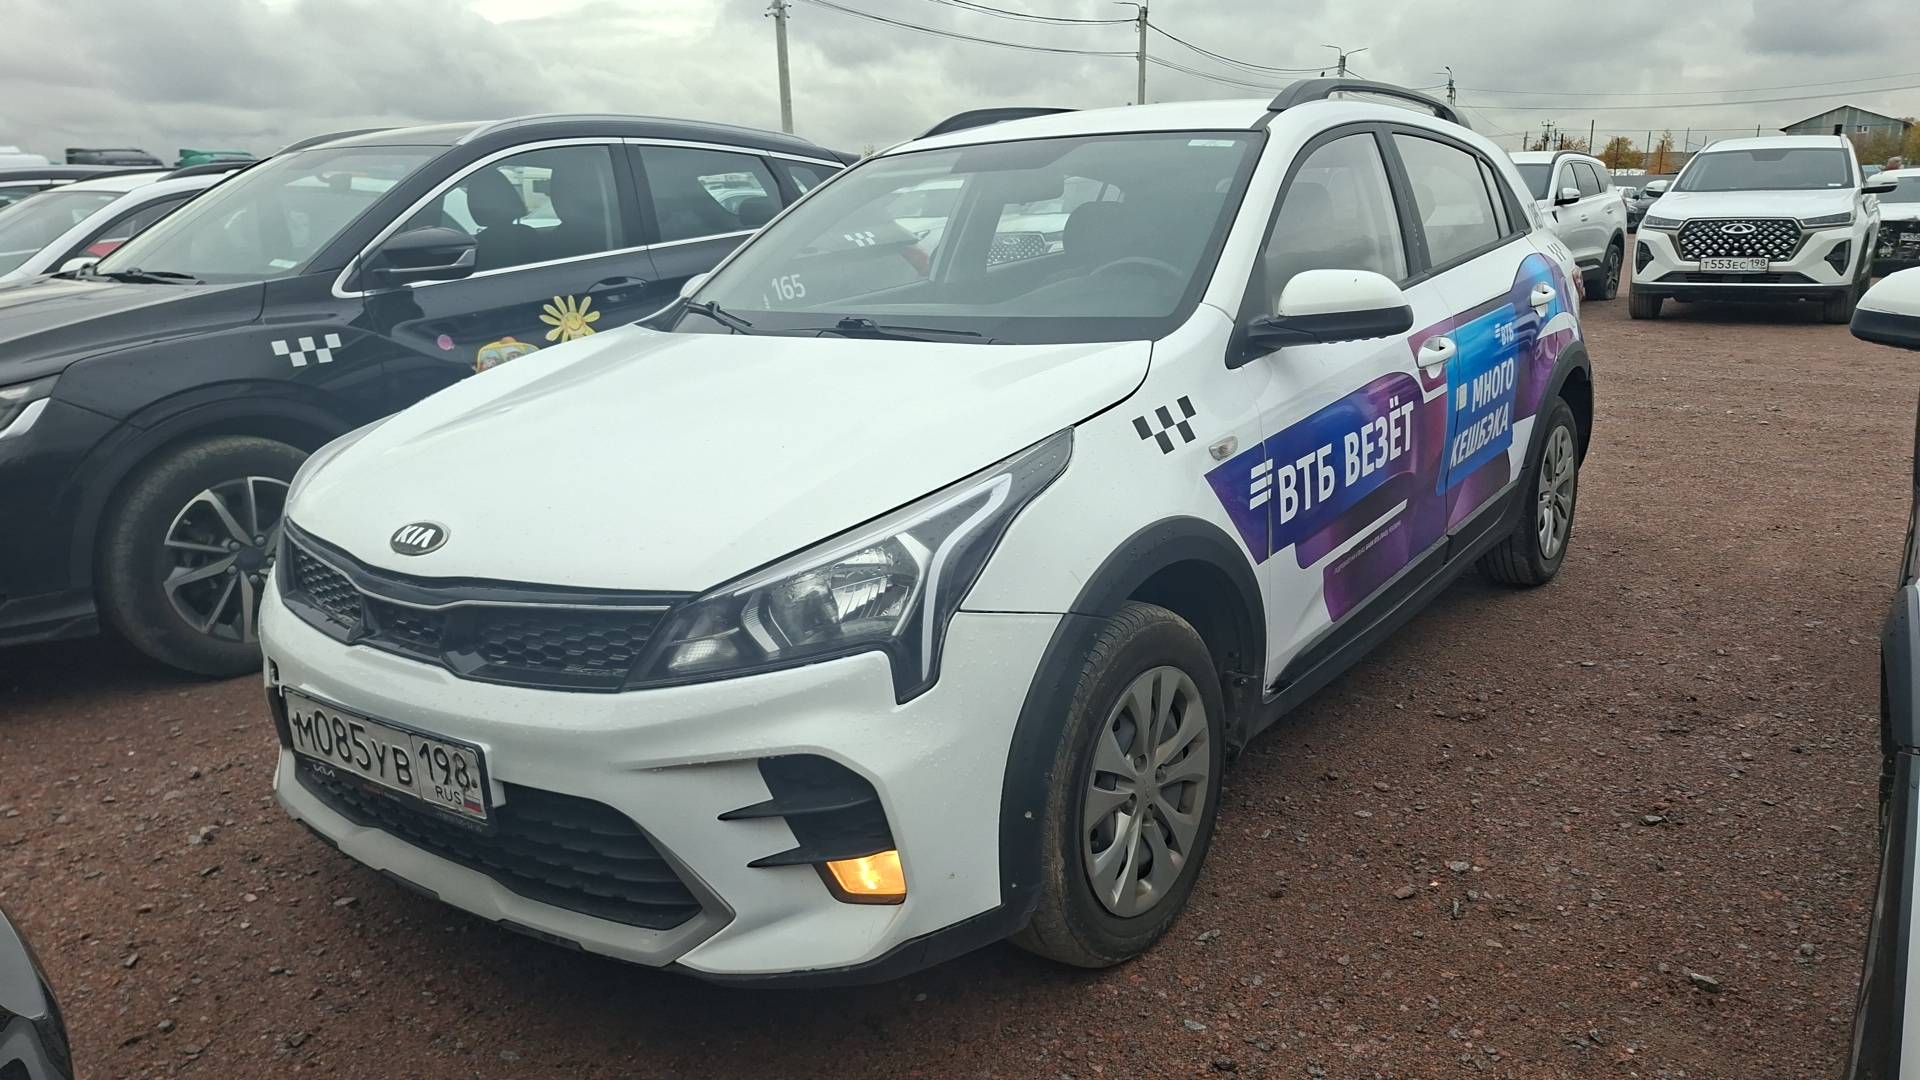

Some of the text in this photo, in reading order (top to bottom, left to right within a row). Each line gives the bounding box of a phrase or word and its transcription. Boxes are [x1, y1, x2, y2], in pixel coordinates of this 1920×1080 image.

[1750, 258, 1766, 267] 198
[771, 273, 806, 301] 165
[1501, 322, 1514, 346] ВТБ
[1471, 357, 1514, 413] МНОГО
[1449, 401, 1509, 470] КЕШБЭКА
[1277, 395, 1414, 525] ВТБ ВЕЗЁТ
[394, 525, 436, 548] KIA
[292, 710, 471, 790] М085УВ 198
[434, 785, 462, 805] RUS
